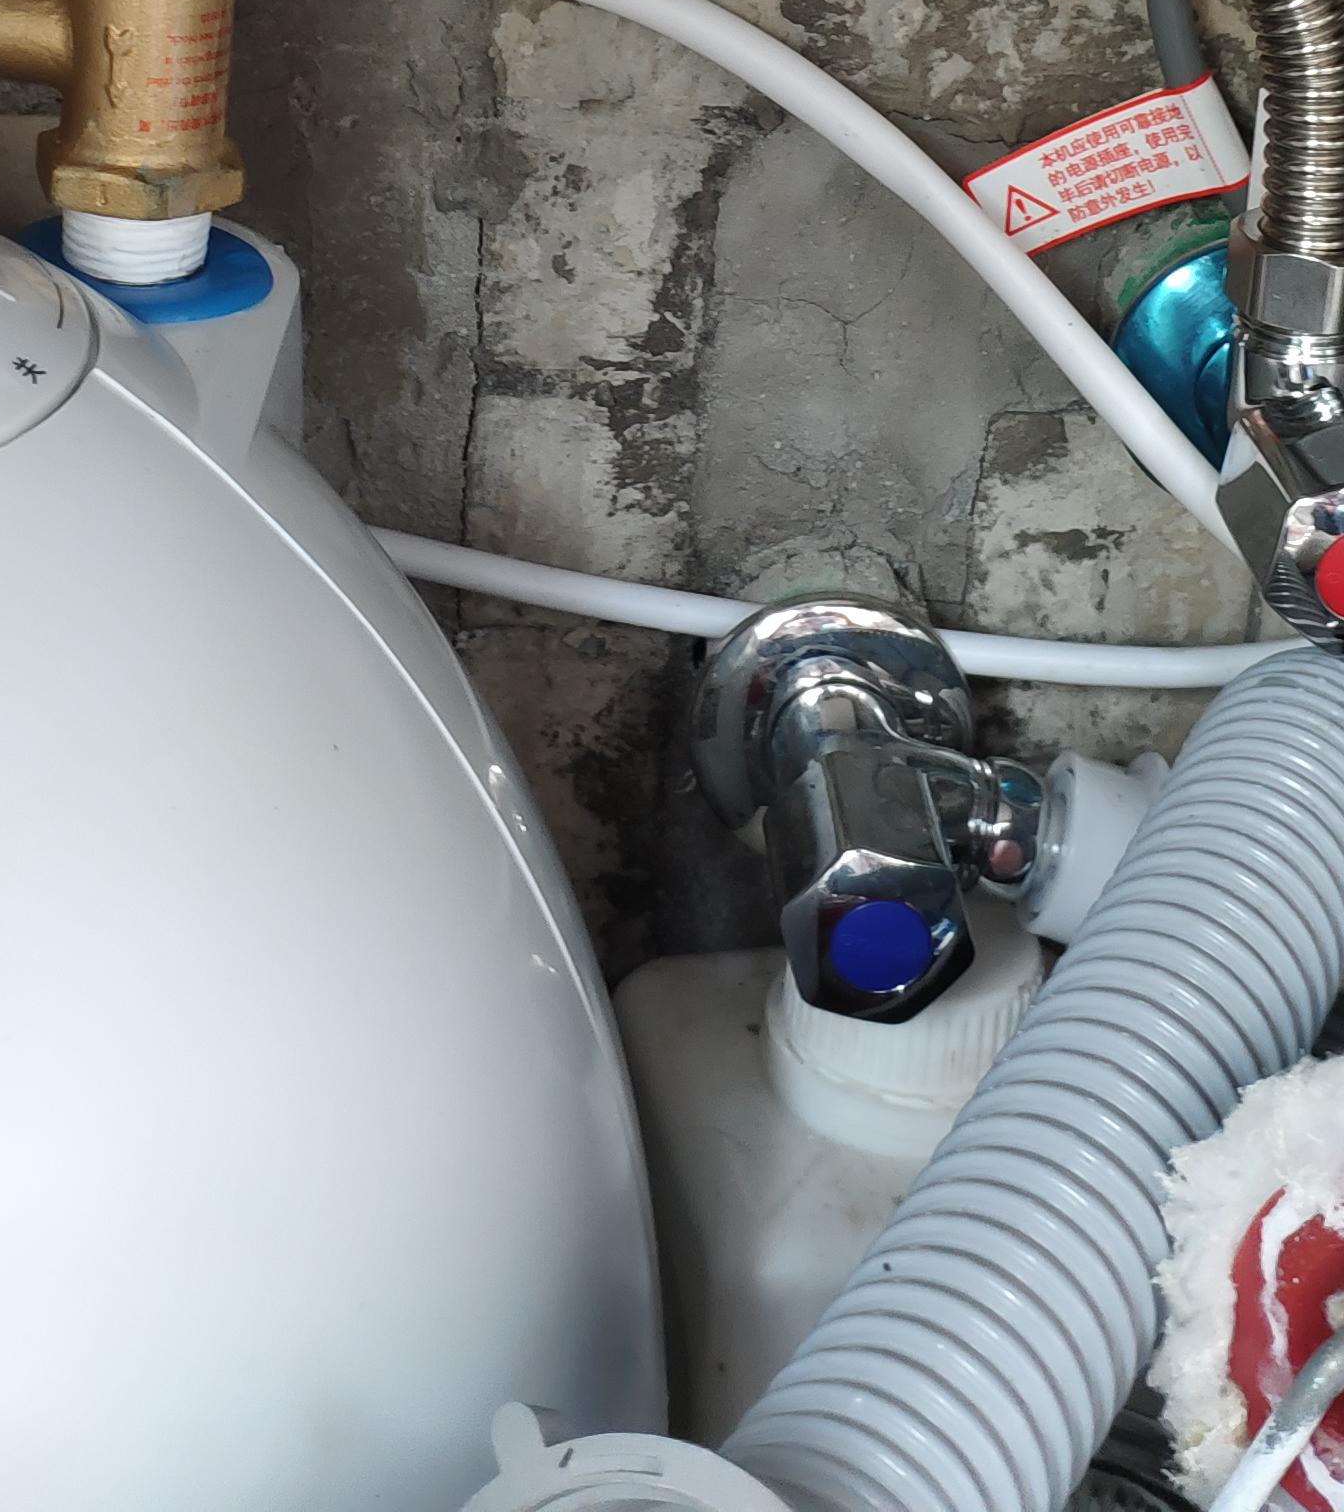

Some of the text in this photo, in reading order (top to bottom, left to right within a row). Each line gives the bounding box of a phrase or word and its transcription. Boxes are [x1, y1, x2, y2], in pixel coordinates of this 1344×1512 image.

[1038, 102, 1185, 169] 本机应使用可靠接地
[12, 356, 47, 385] 关
